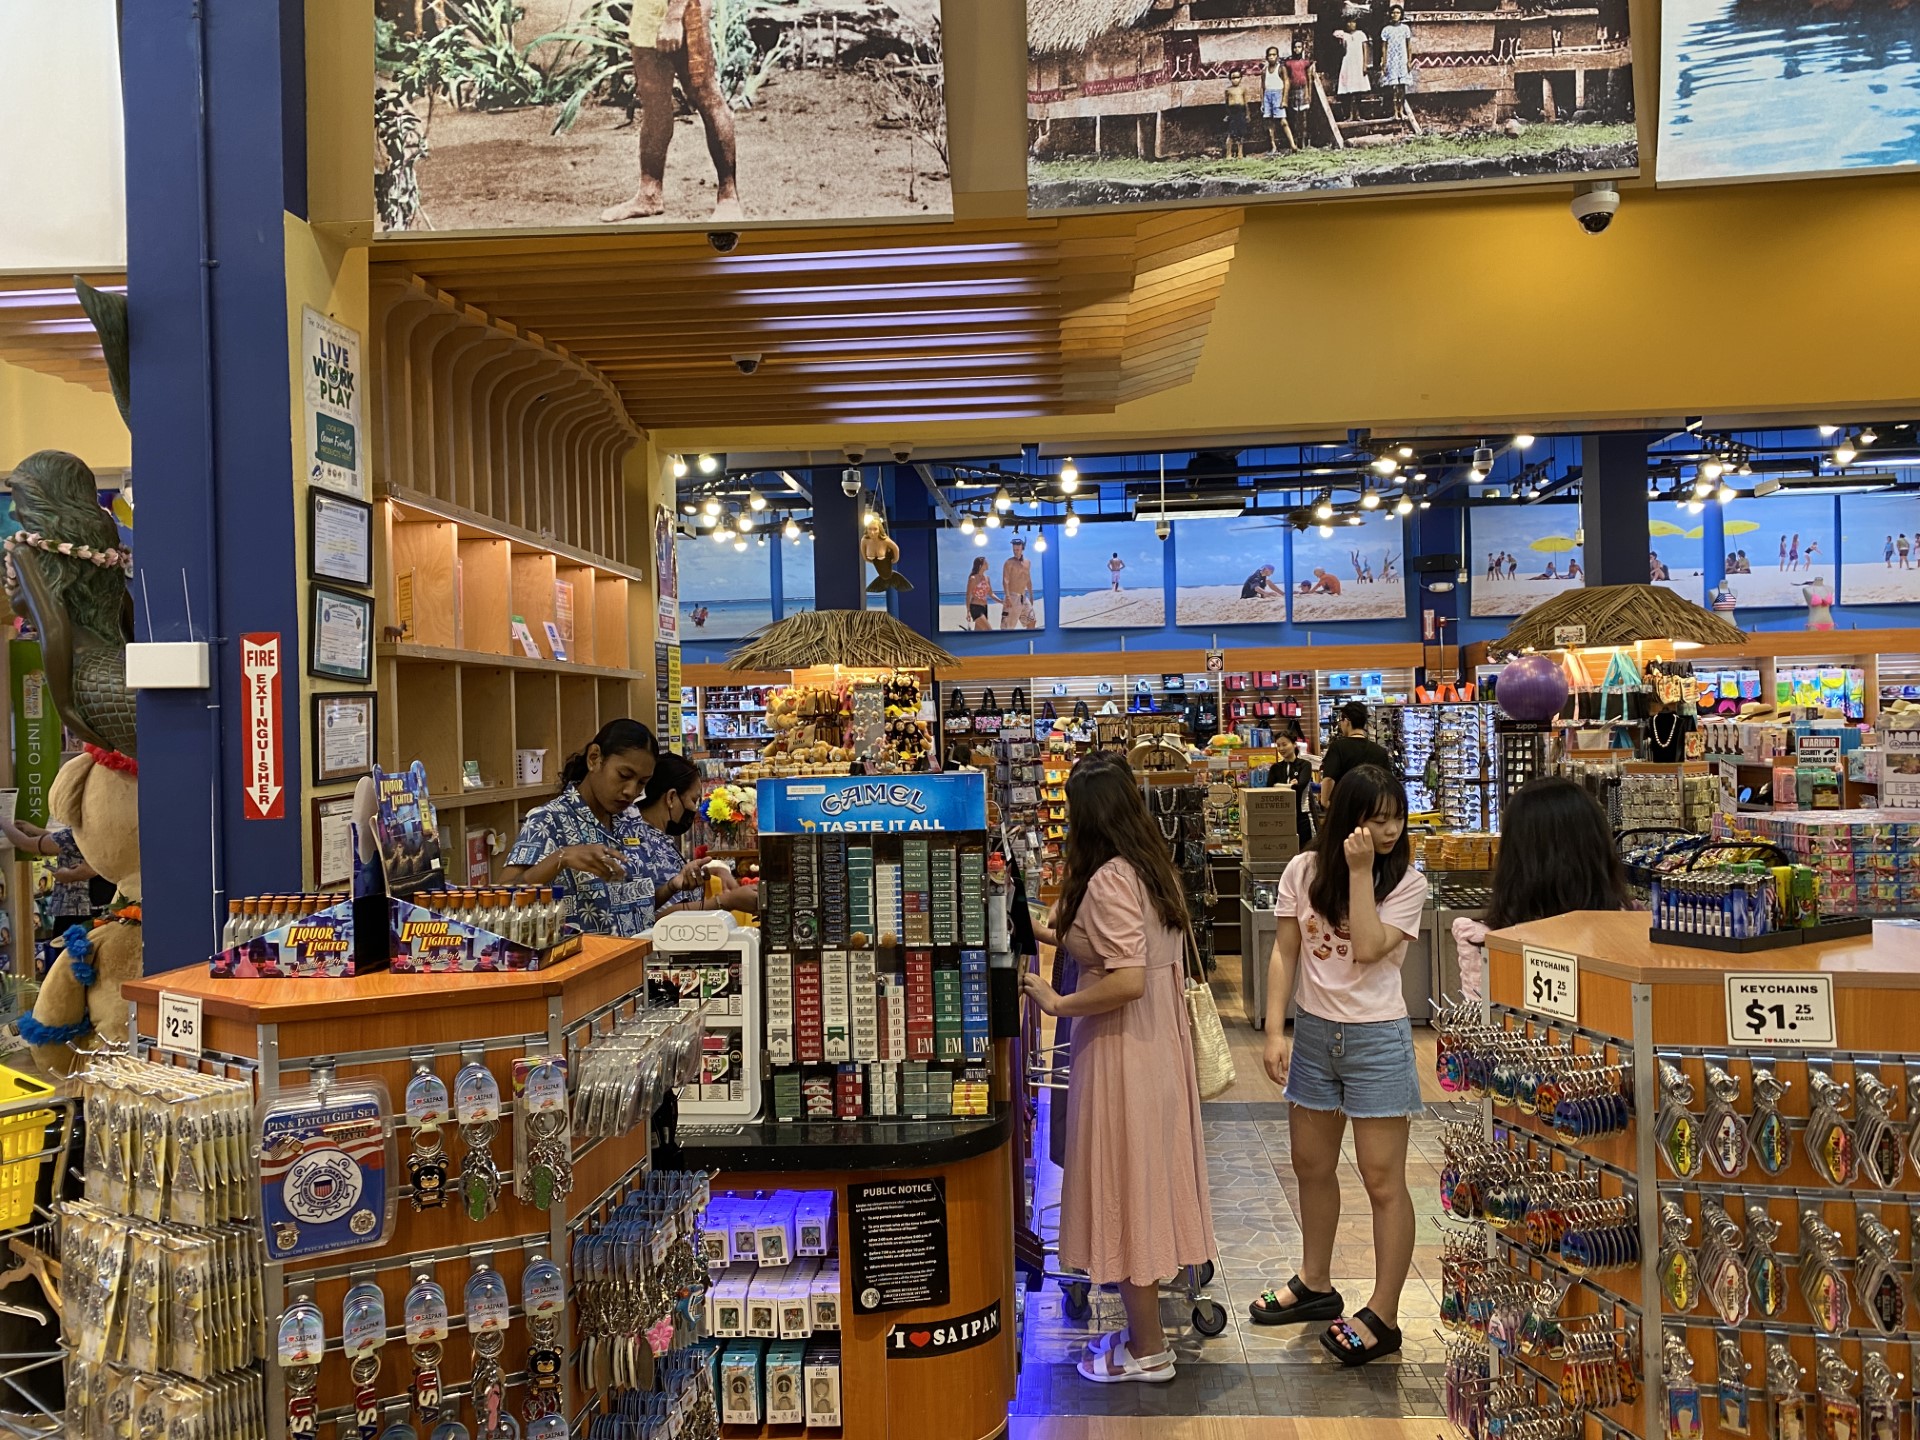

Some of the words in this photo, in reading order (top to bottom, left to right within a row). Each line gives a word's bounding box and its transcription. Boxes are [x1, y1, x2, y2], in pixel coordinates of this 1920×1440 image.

[320, 337, 349, 369] LIVE
[312, 355, 355, 392] WORK
[320, 380, 352, 410] PLAY
[334, 436, 353, 456] Friendly
[246, 649, 275, 668] FIRE
[27, 723, 41, 765] INFO
[256, 673, 270, 806] EXTINGUISHER
[1802, 739, 1836, 747] WARNING
[28, 773, 42, 818] DESK
[821, 783, 927, 816] CAMEL
[820, 819, 884, 833] TASTE
[888, 819, 906, 832] IT
[909, 818, 945, 831] ALL
[794, 909, 815, 917] CAMEL
[286, 926, 335, 948] LIQUOR
[401, 922, 449, 942] LIQUOR
[305, 941, 348, 957] LIGHTER
[420, 935, 463, 952] LIGHTER
[1530, 958, 1570, 973] KEYCHAINS
[800, 976, 817, 984] Marlboro
[1557, 981, 1566, 990] 25
[800, 987, 818, 995] Marlboro
[1740, 985, 1818, 994] KEYCHAINS
[800, 997, 818, 1005] Marlboro
[801, 1008, 818, 1016] Marlboro
[1795, 1004, 1811, 1015] 25
[166, 1016, 193, 1037] $2.95
[801, 1018, 819, 1026] Marlboro
[802, 1039, 819, 1047] Marlboro
[918, 1038, 934, 1054] L&M
[945, 1038, 962, 1054] L&M
[973, 1037, 989, 1053] L&M
[770, 1048, 790, 1058] Marlboro
[802, 1050, 819, 1058] Marlboro
[827, 1047, 847, 1057] Marlboro
[423, 1096, 443, 1105] SAIPAN
[474, 1094, 493, 1102] SAIPAN
[267, 1121, 287, 1131] PIN
[288, 1120, 296, 1128] &
[297, 1116, 331, 1128] PATCH
[332, 1111, 356, 1123] GIFT
[357, 1108, 376, 1118] SET
[333, 1131, 367, 1142] GUARD
[1723, 1138, 1731, 1162] SAIPAN
[324, 1169, 342, 1181] COAST
[863, 1186, 897, 1198] PUBLIC
[898, 1184, 932, 1194] NOTICE
[304, 1245, 324, 1253] PATCH
[540, 1286, 559, 1294] SAIPAN
[421, 1313, 442, 1321] SAIPAN
[359, 1321, 380, 1332] SAIPAN
[895, 1332, 905, 1349] I
[933, 1310, 997, 1346] SAIPAN
[296, 1334, 318, 1342] SAIPAN
[416, 1369, 440, 1425] USA
[544, 1431, 565, 1439] SAIPAN
